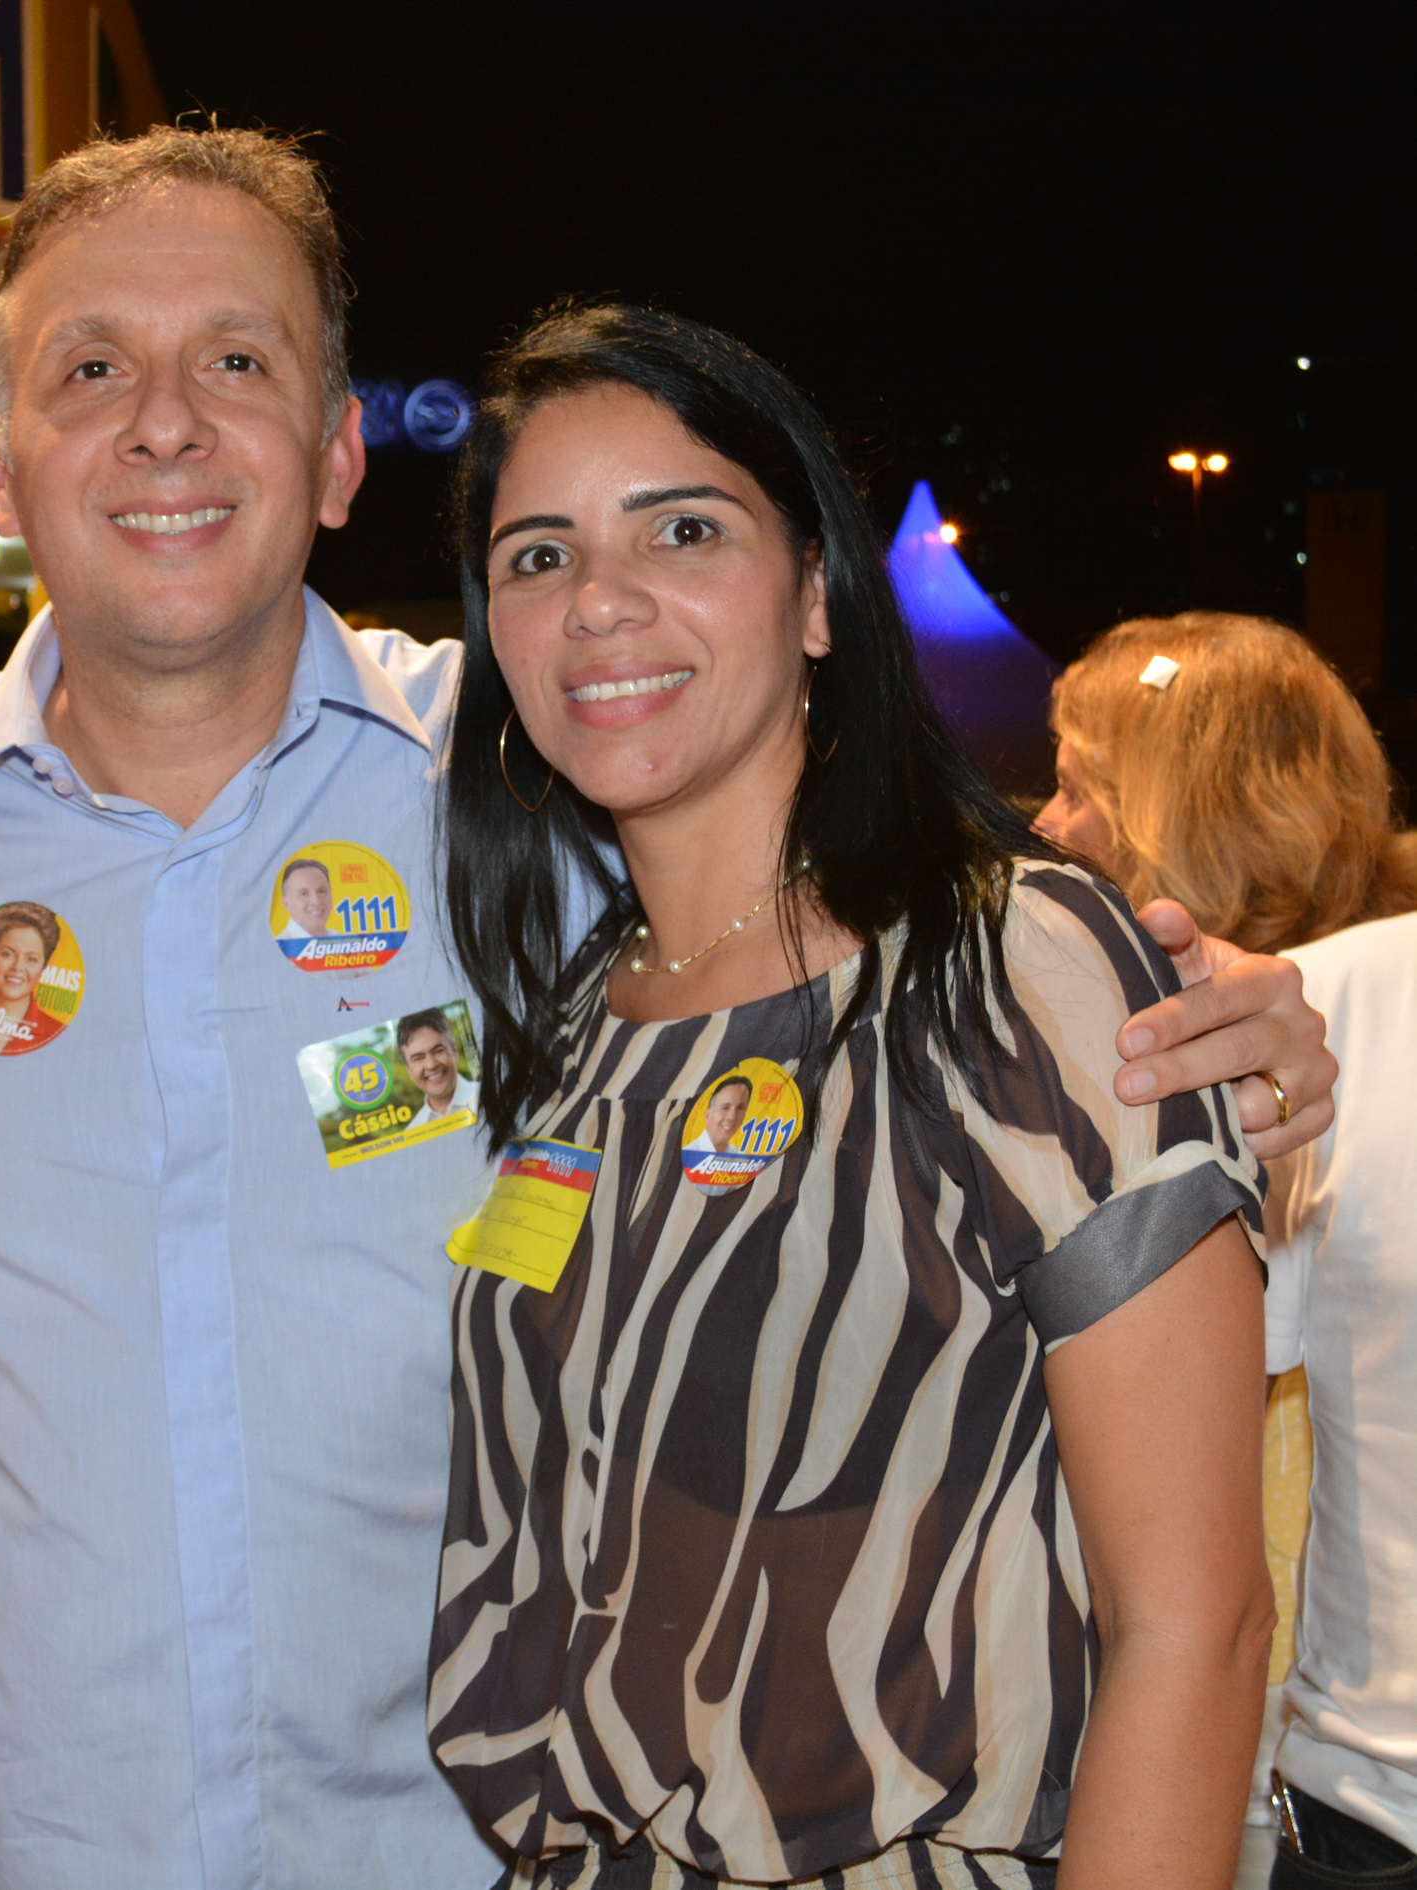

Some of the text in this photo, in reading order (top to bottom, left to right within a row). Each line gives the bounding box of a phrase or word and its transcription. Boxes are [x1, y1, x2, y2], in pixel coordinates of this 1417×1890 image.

[335, 894, 398, 933] 1111
[295, 937, 388, 961] Aguinaldo
[324, 952, 377, 968] Ribeiro
[39, 964, 82, 991] MAIS
[35, 984, 77, 1015] FUTURO
[343, 1061, 380, 1094] 45
[338, 1104, 412, 1140] Cássio
[738, 1117, 796, 1154] 1111
[546, 1152, 578, 1177] 1111
[689, 1154, 766, 1175] Aguinaldo
[710, 1171, 749, 1184] Ribeiro
